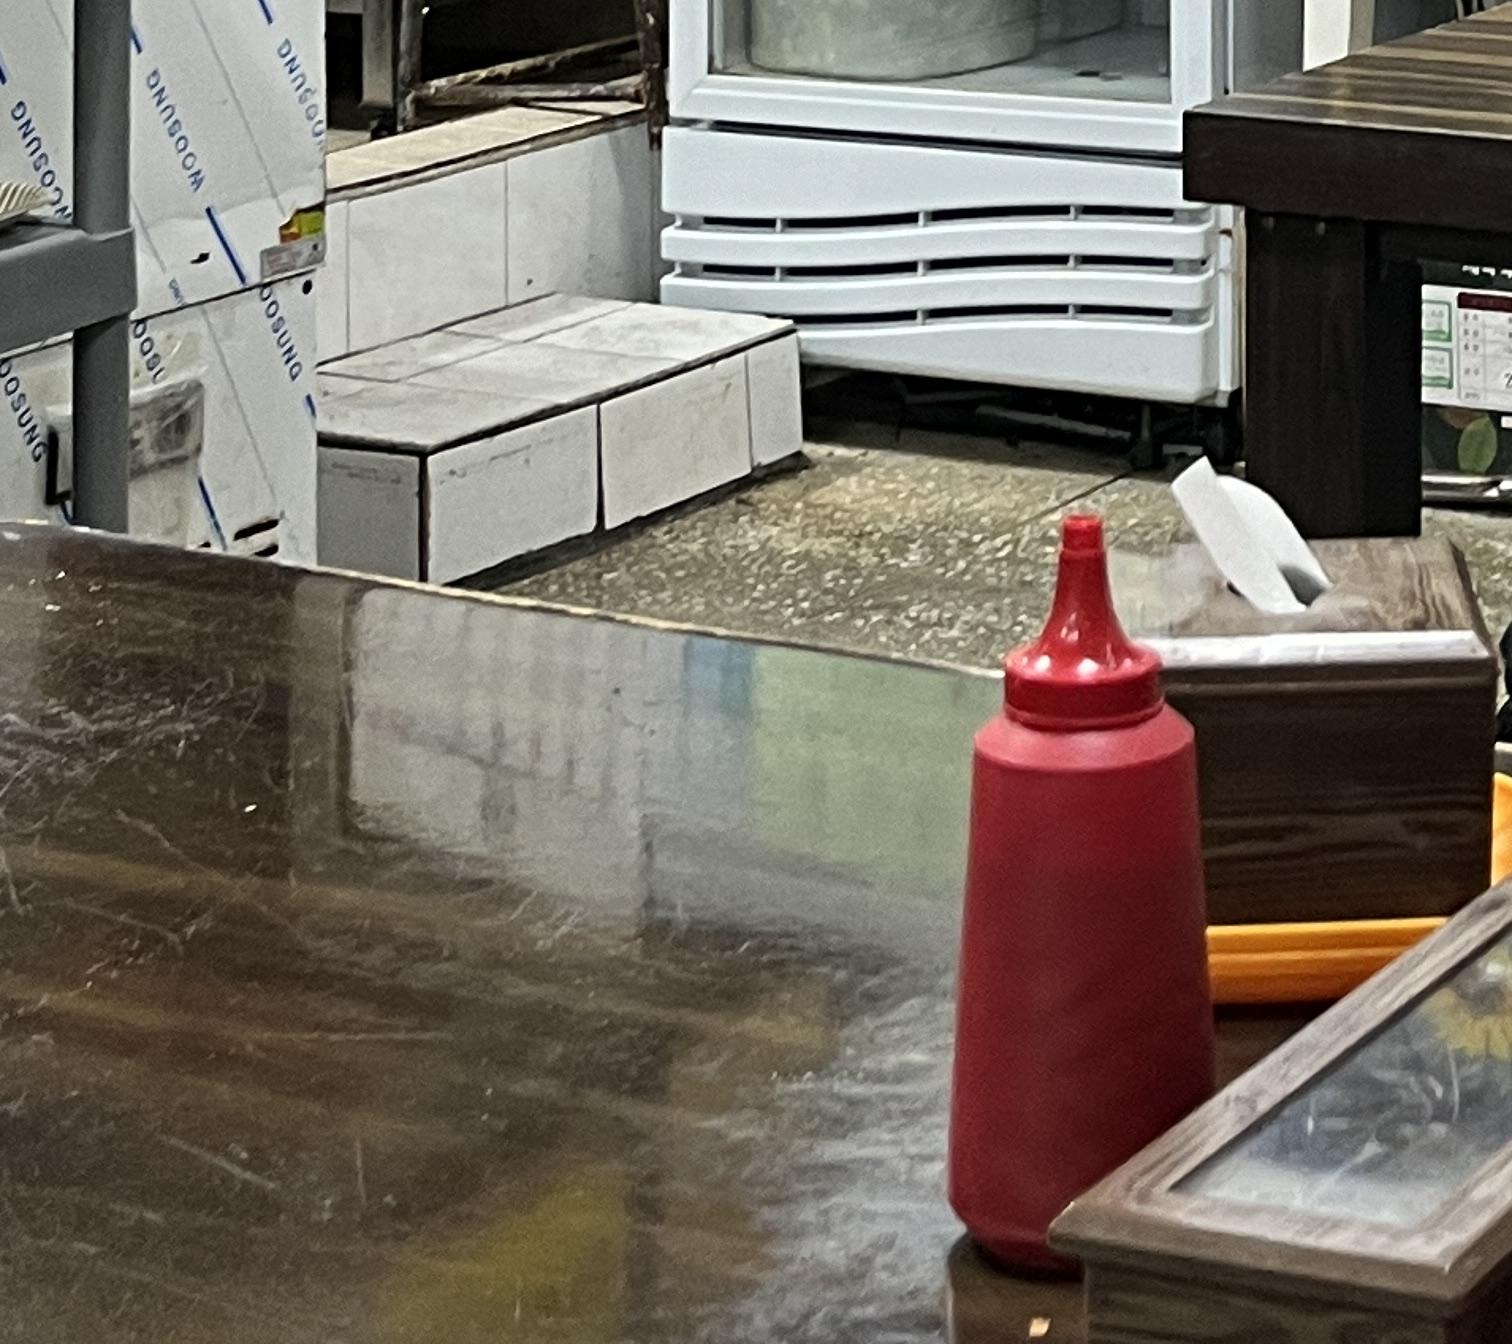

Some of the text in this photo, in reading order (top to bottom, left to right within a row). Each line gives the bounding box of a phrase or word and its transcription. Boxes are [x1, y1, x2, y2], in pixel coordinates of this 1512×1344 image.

[146, 67, 206, 193] WOOSUNG
[277, 38, 325, 154] OOSUNG
[258, 286, 303, 382] OOSUNG
[0, 361, 49, 463] OOSUNG
